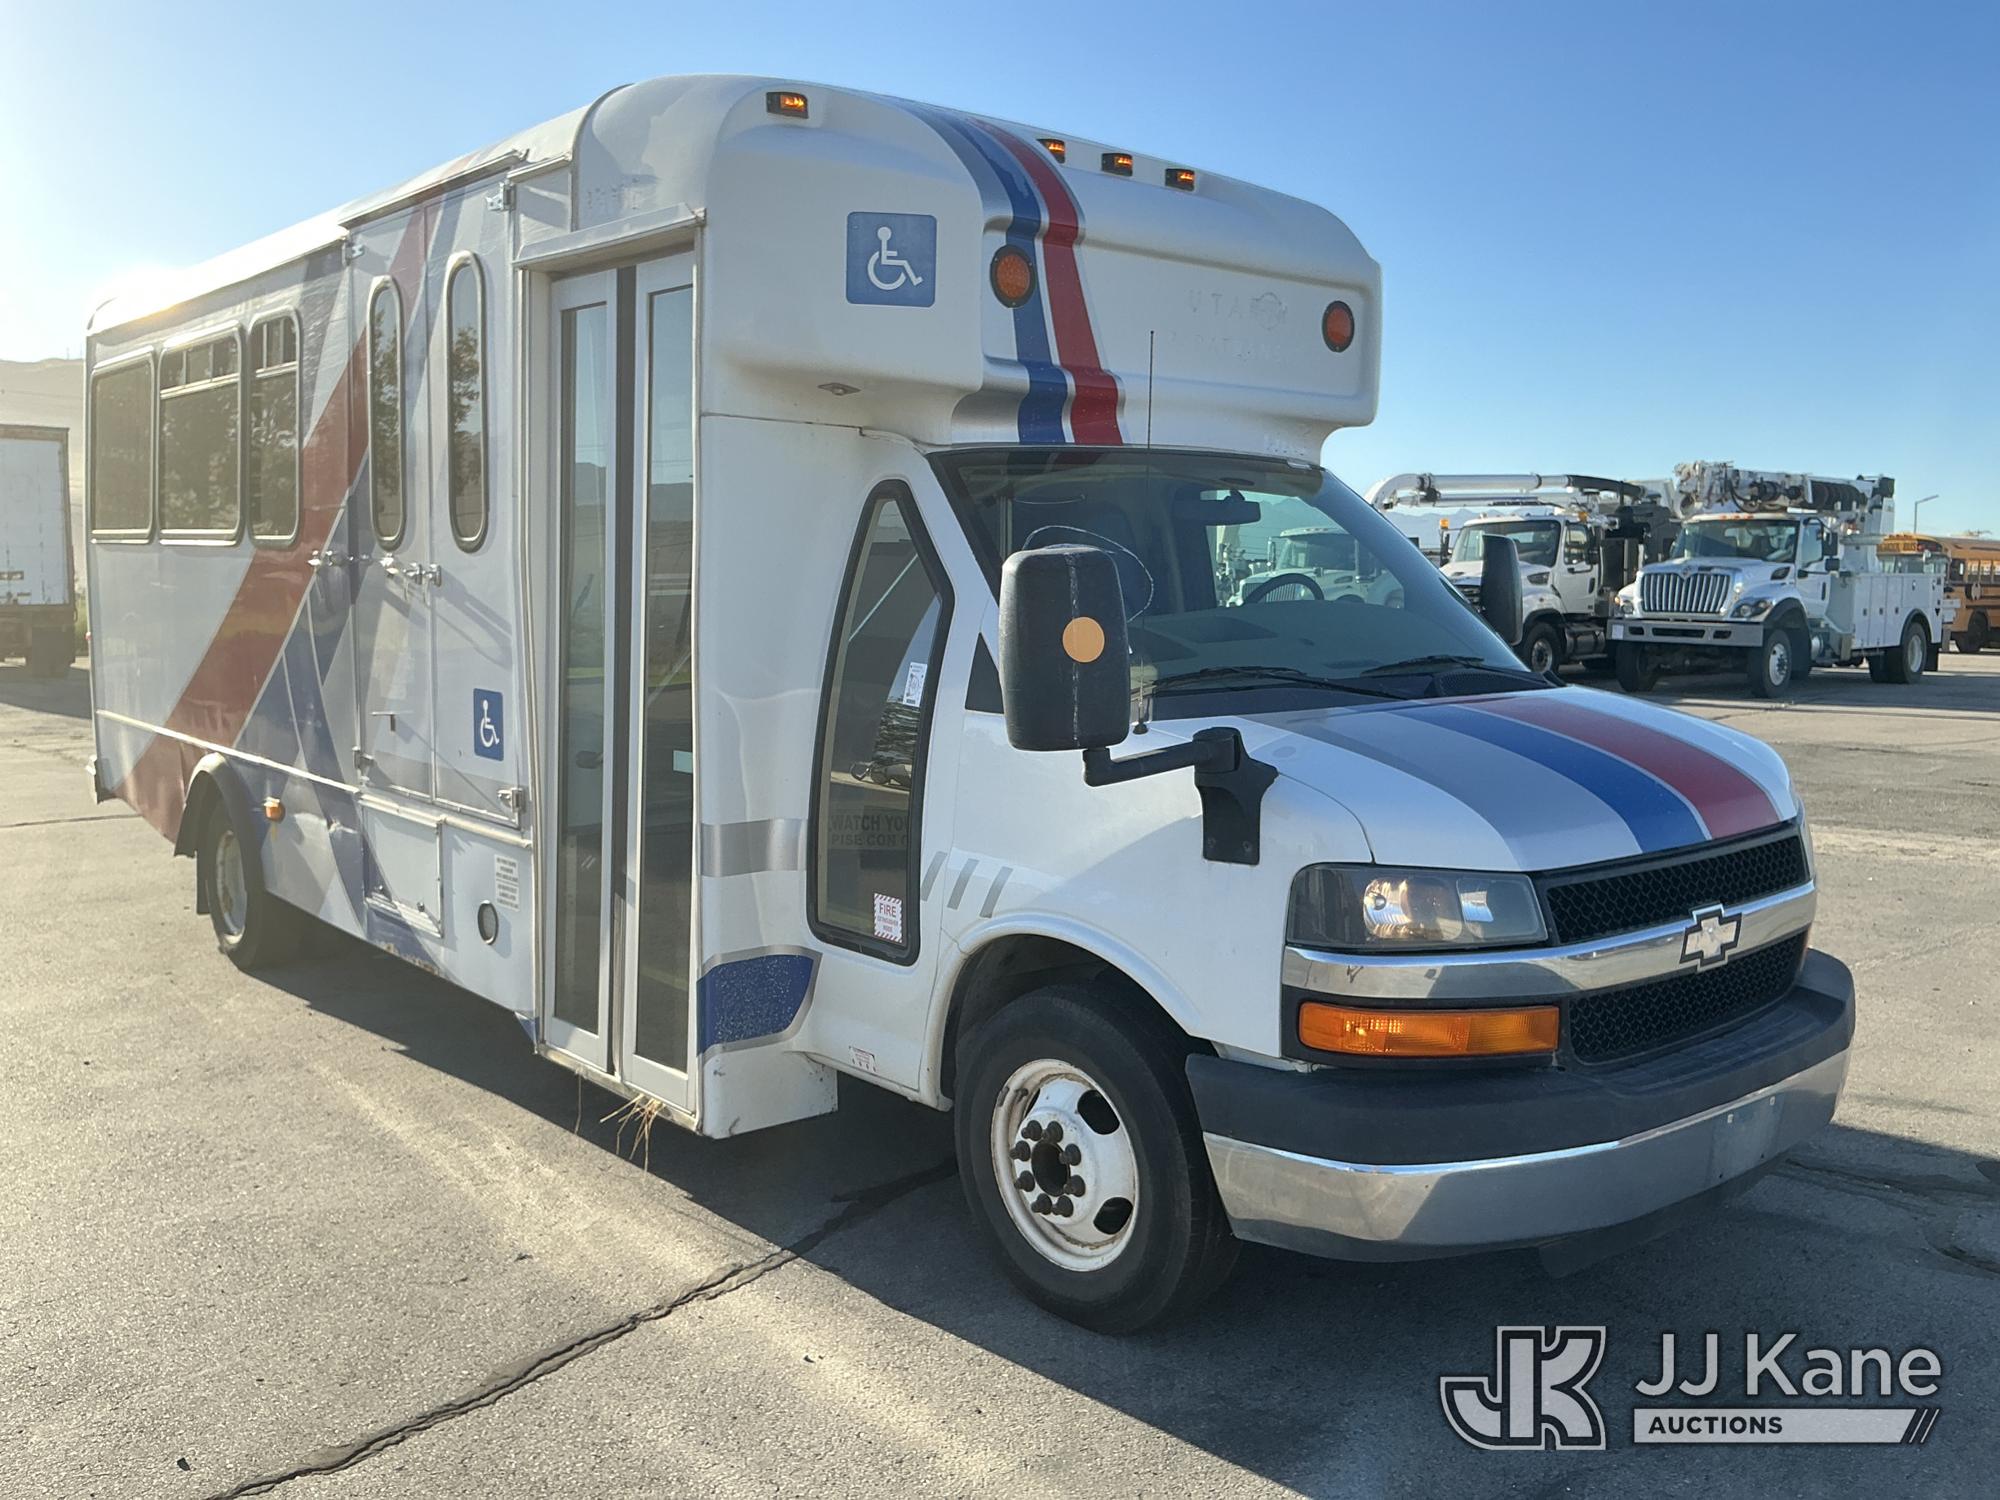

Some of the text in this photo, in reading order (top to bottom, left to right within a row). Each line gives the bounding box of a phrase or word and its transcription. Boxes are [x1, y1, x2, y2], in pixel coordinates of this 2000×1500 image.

[831, 815, 881, 832] WATCH
[831, 834, 863, 846] PISE
[879, 902, 897, 918] FIRE
